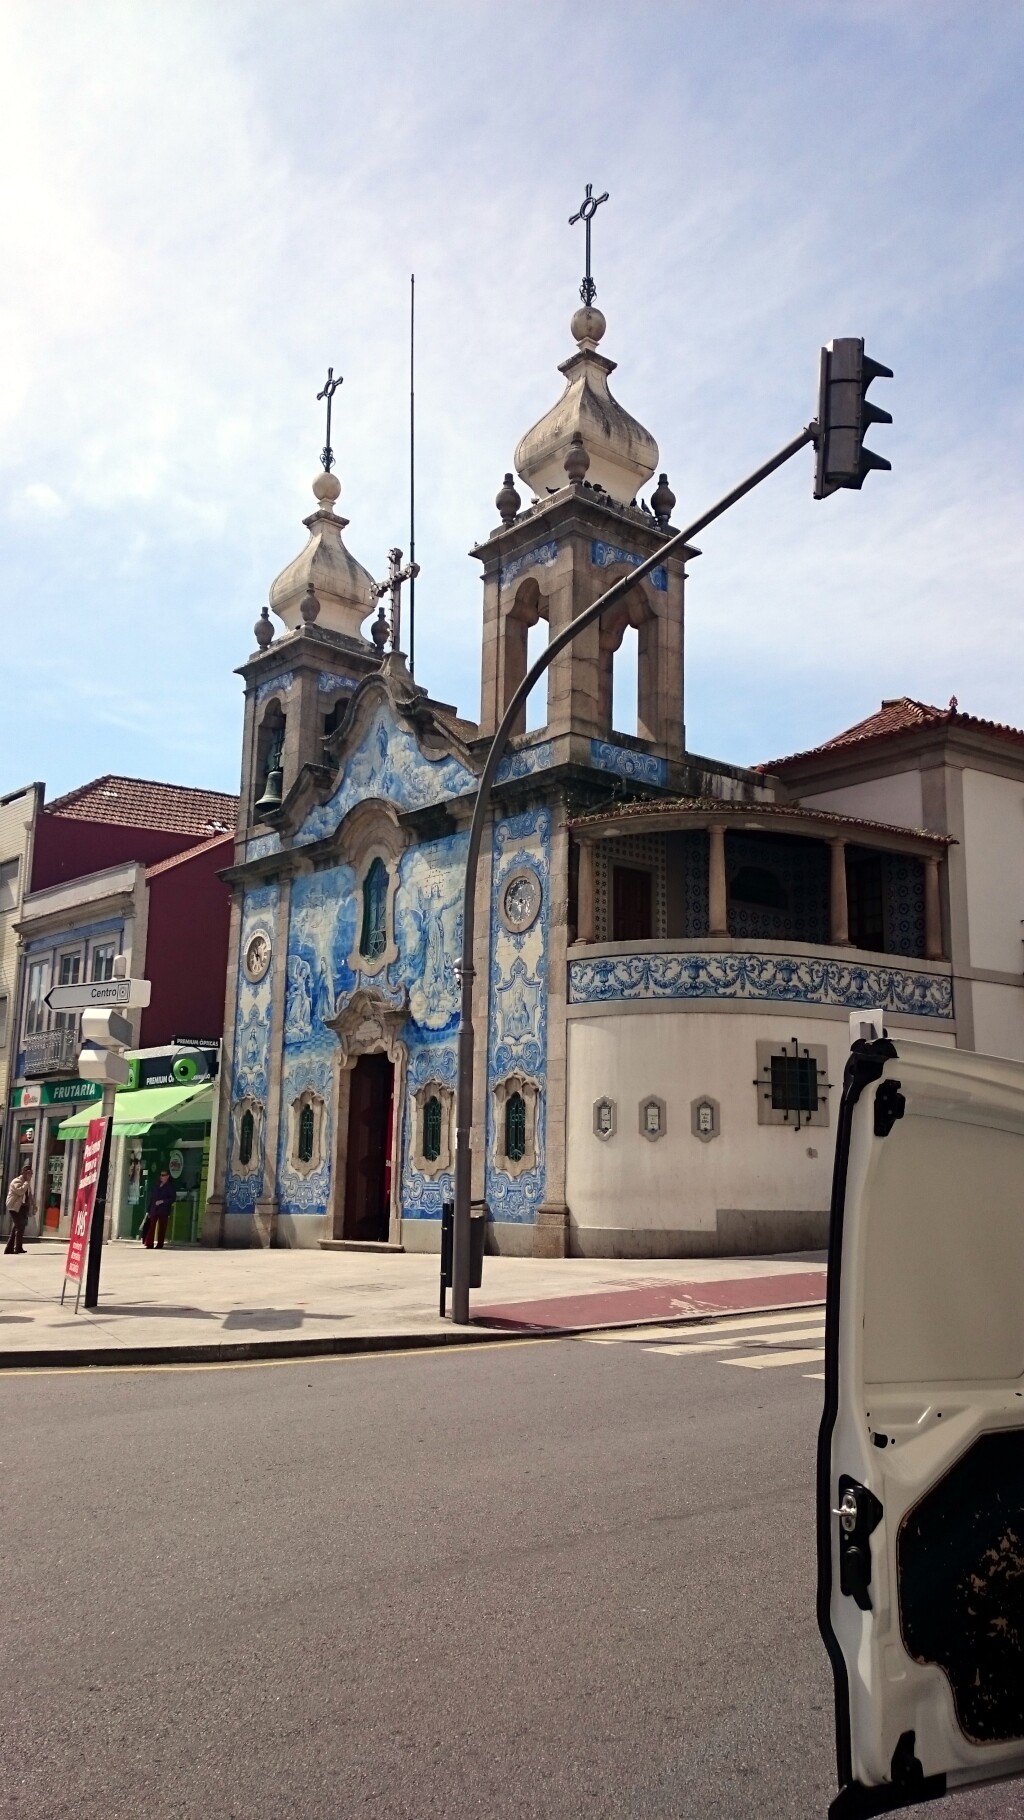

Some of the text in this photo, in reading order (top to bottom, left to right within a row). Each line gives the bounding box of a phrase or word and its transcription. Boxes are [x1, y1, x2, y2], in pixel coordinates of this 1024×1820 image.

[91, 988, 116, 998] Centro
[146, 1075, 168, 1085] PREMIUM
[53, 1083, 96, 1099] FRUTARIA
